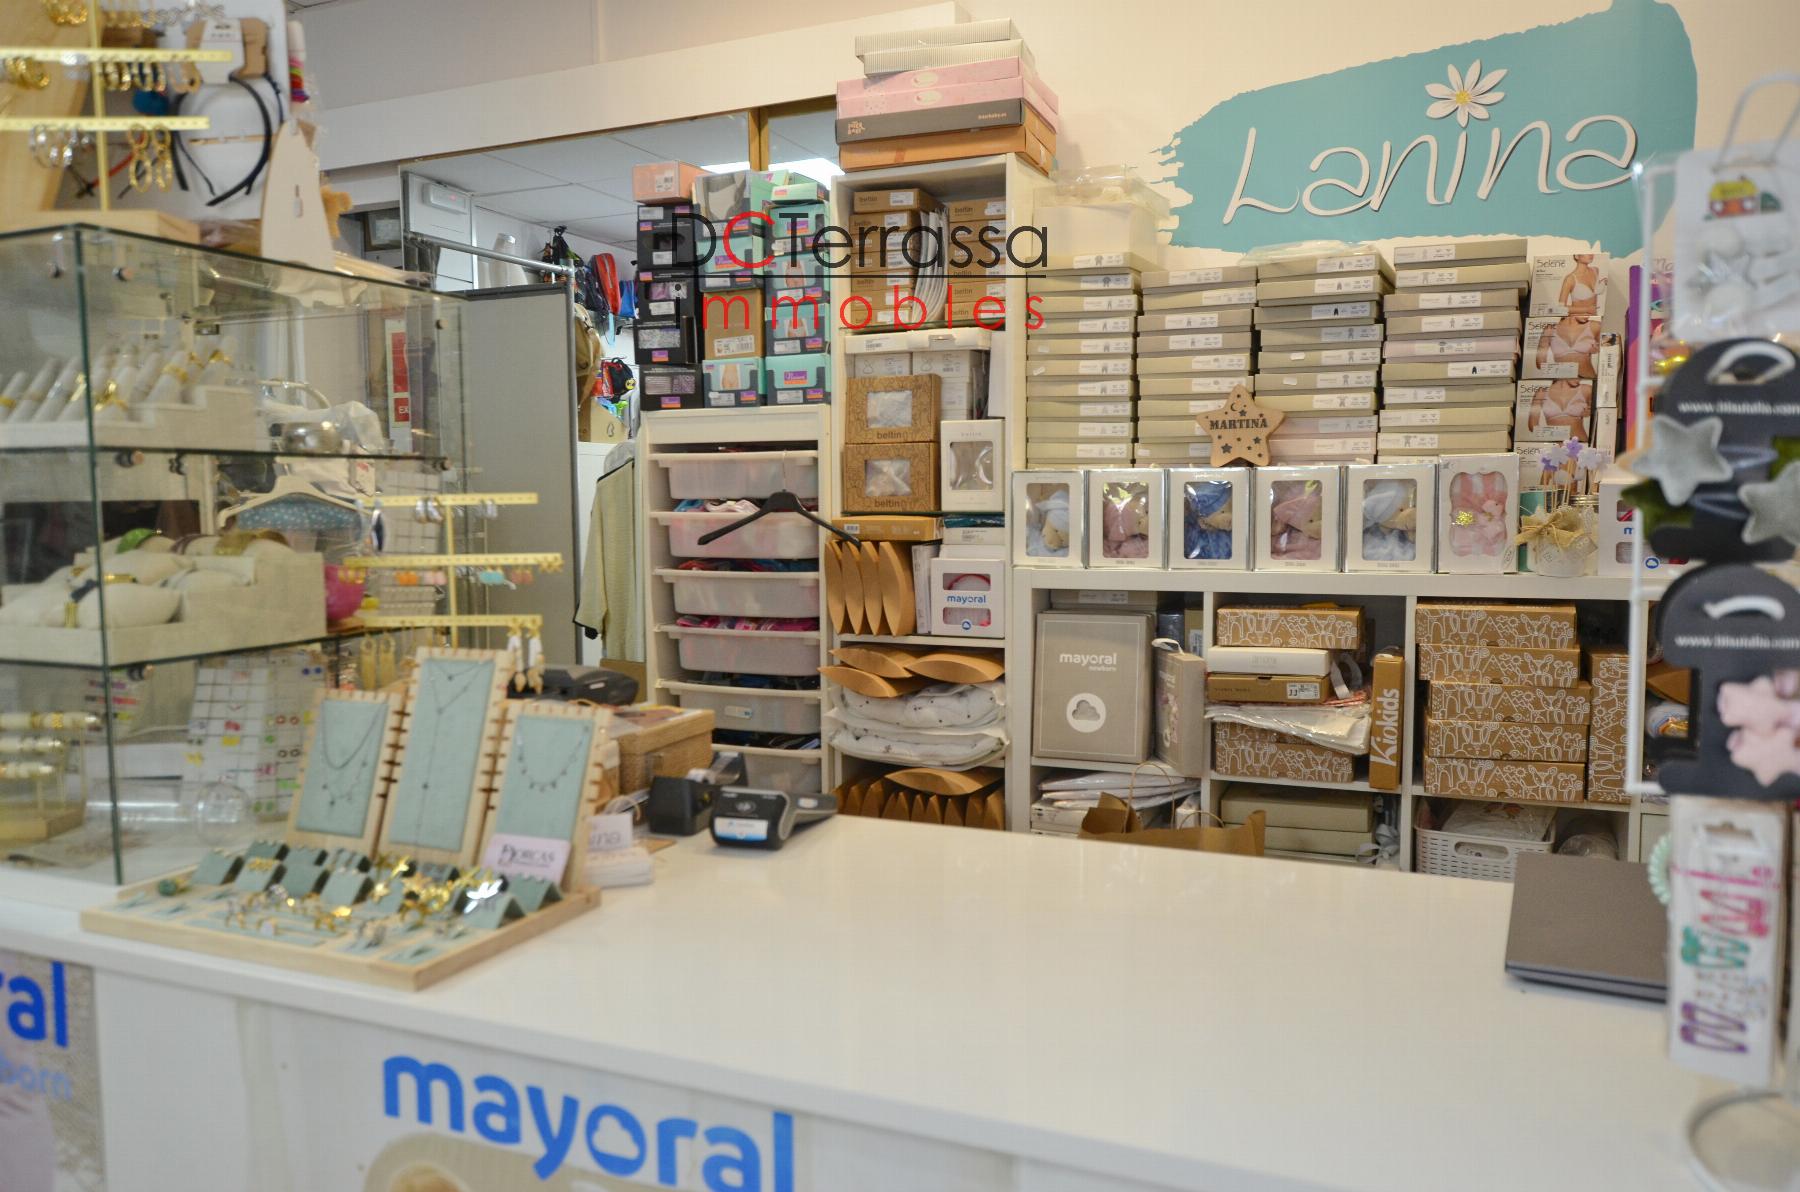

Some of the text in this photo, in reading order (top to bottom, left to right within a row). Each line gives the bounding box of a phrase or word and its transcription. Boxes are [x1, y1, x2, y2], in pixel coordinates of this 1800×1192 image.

[1222, 113, 1638, 226] Lanina
[1209, 418, 1268, 430] MARTINA
[946, 594, 987, 605] mayoral
[1059, 652, 1118, 667] mayoral
[1369, 688, 1400, 767] Kiokids
[383, 1055, 794, 1192] mayoral
